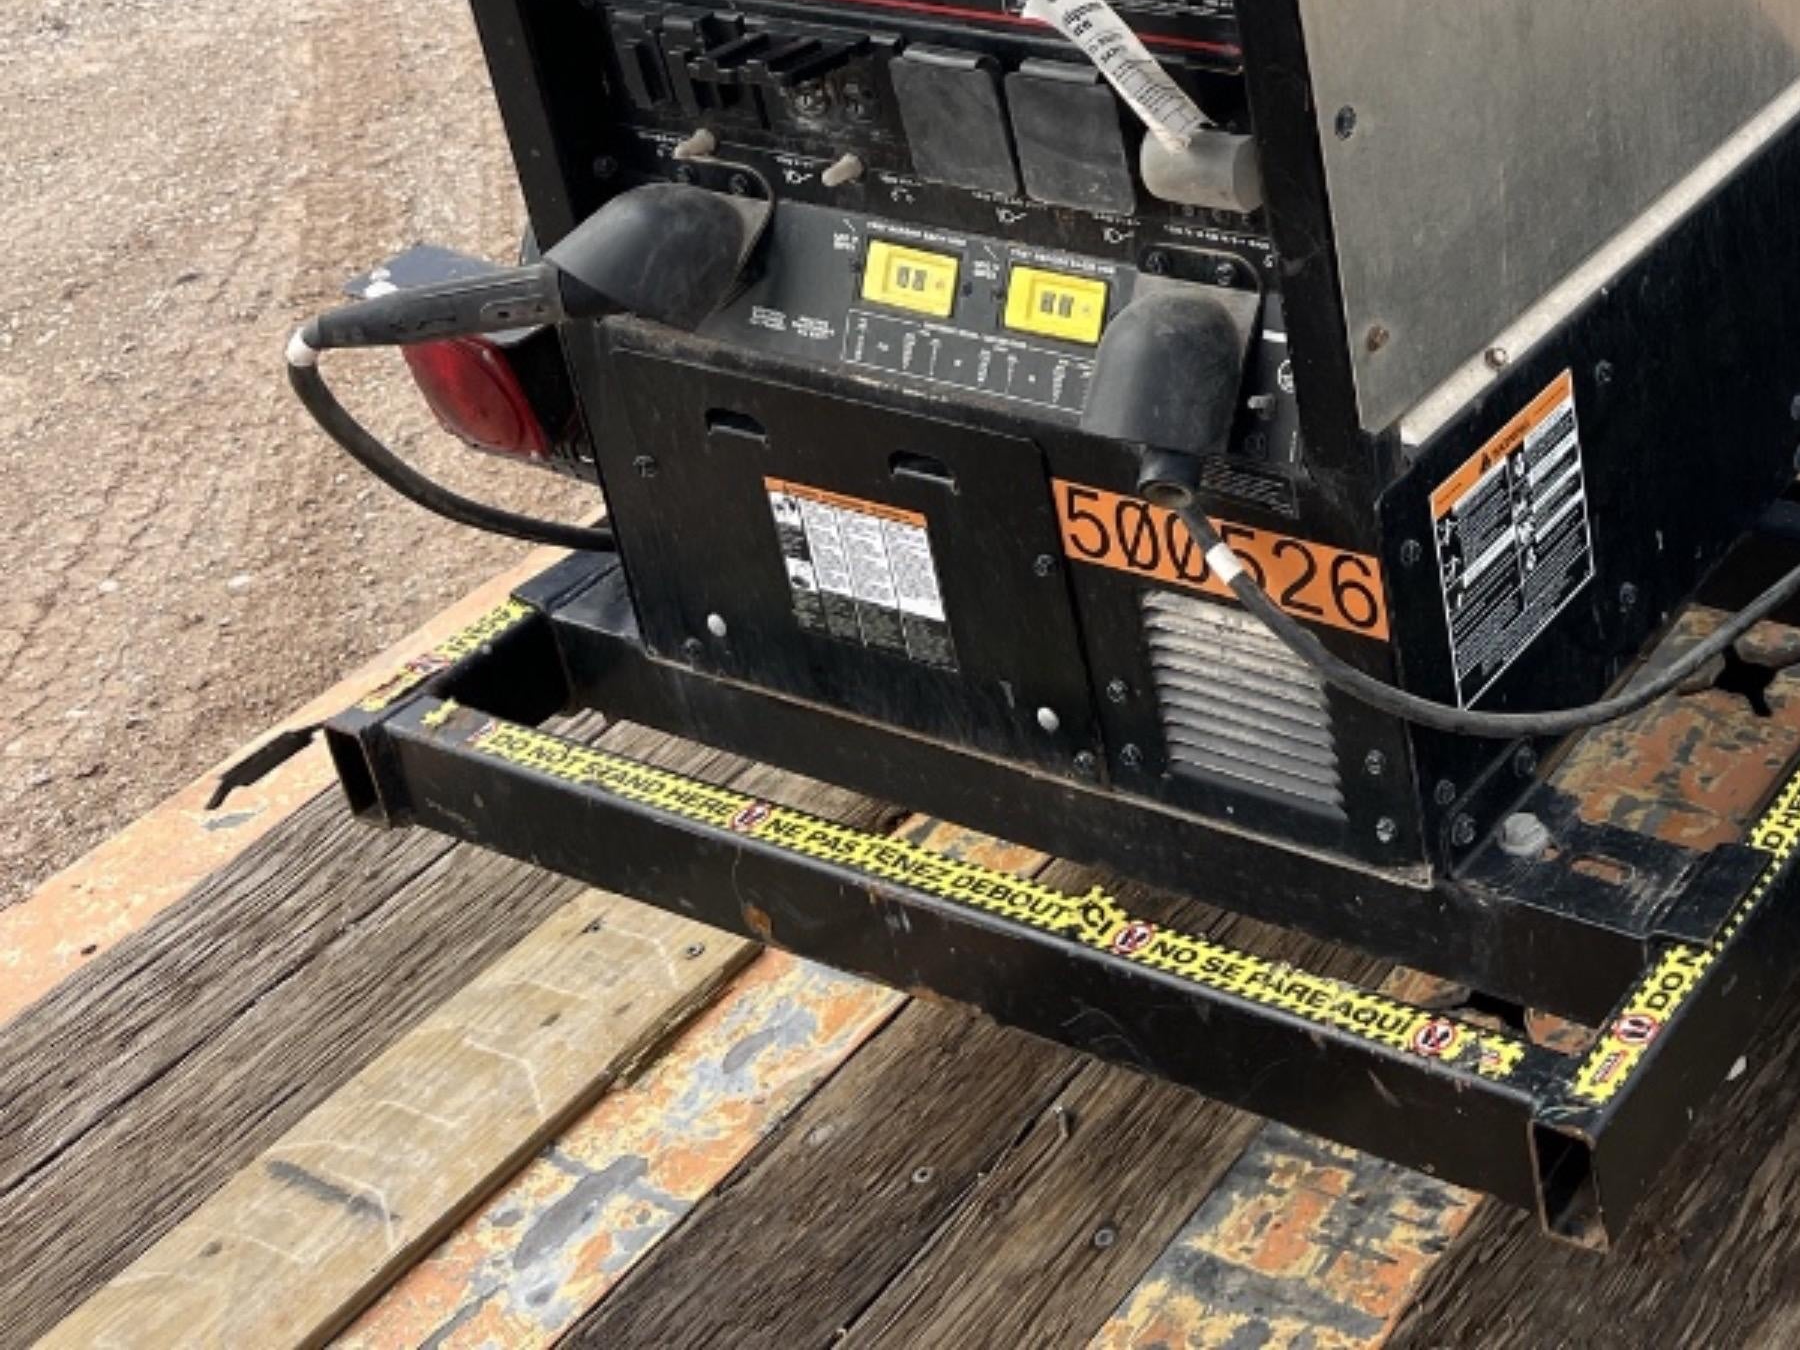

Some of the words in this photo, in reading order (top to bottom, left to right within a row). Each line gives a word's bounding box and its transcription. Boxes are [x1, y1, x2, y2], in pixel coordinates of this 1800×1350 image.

[489, 733, 530, 751] DO
[527, 743, 582, 769] NOT
[581, 761, 668, 792] STAND
[666, 786, 739, 816] HERE
[761, 818, 806, 838] NE
[803, 830, 861, 855] PAS
[864, 841, 950, 882] TENEZ
[950, 874, 1074, 921] DEBOUT
[1148, 941, 1199, 965] NO
[1199, 956, 1246, 979] SE
[1245, 970, 1330, 1010] PARE
[1646, 970, 1684, 1012] DO
